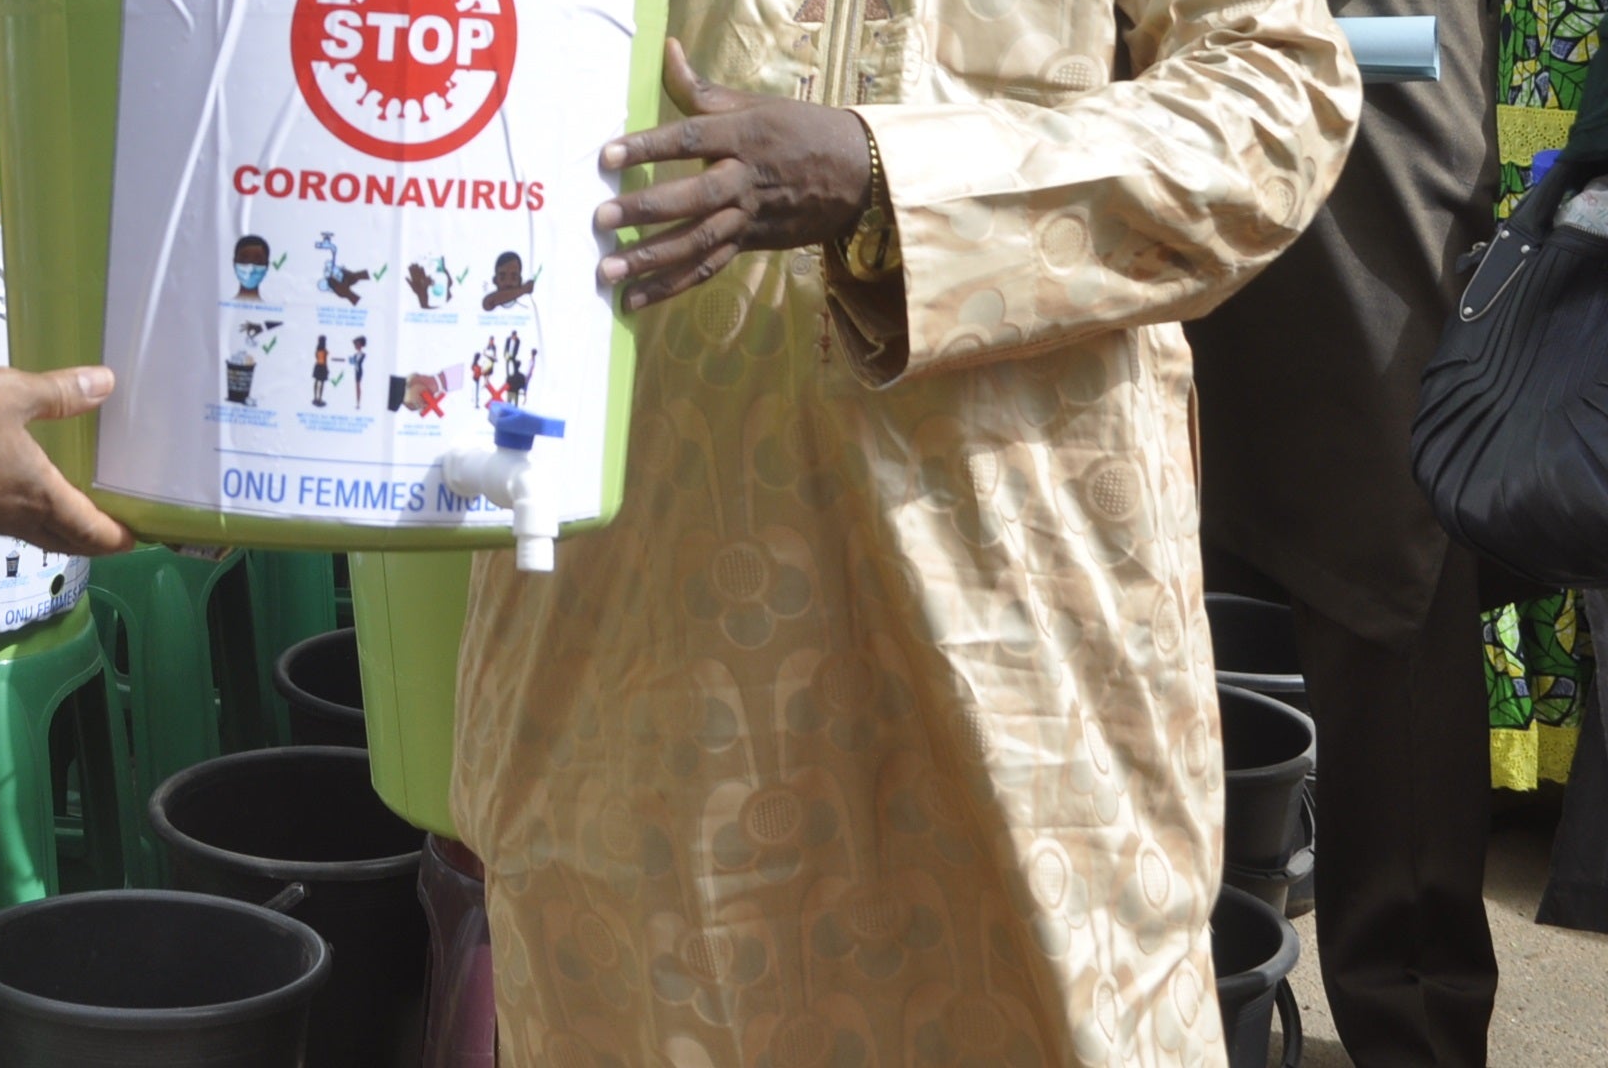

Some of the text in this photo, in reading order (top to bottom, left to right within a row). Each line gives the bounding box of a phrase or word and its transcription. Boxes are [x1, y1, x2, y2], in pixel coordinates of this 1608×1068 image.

[320, 9, 496, 66] STOP
[233, 164, 545, 211] CORONAVIRUS
[223, 468, 287, 503] ONU
[298, 475, 426, 512] FEMMES
[5, 605, 33, 625] ONU
